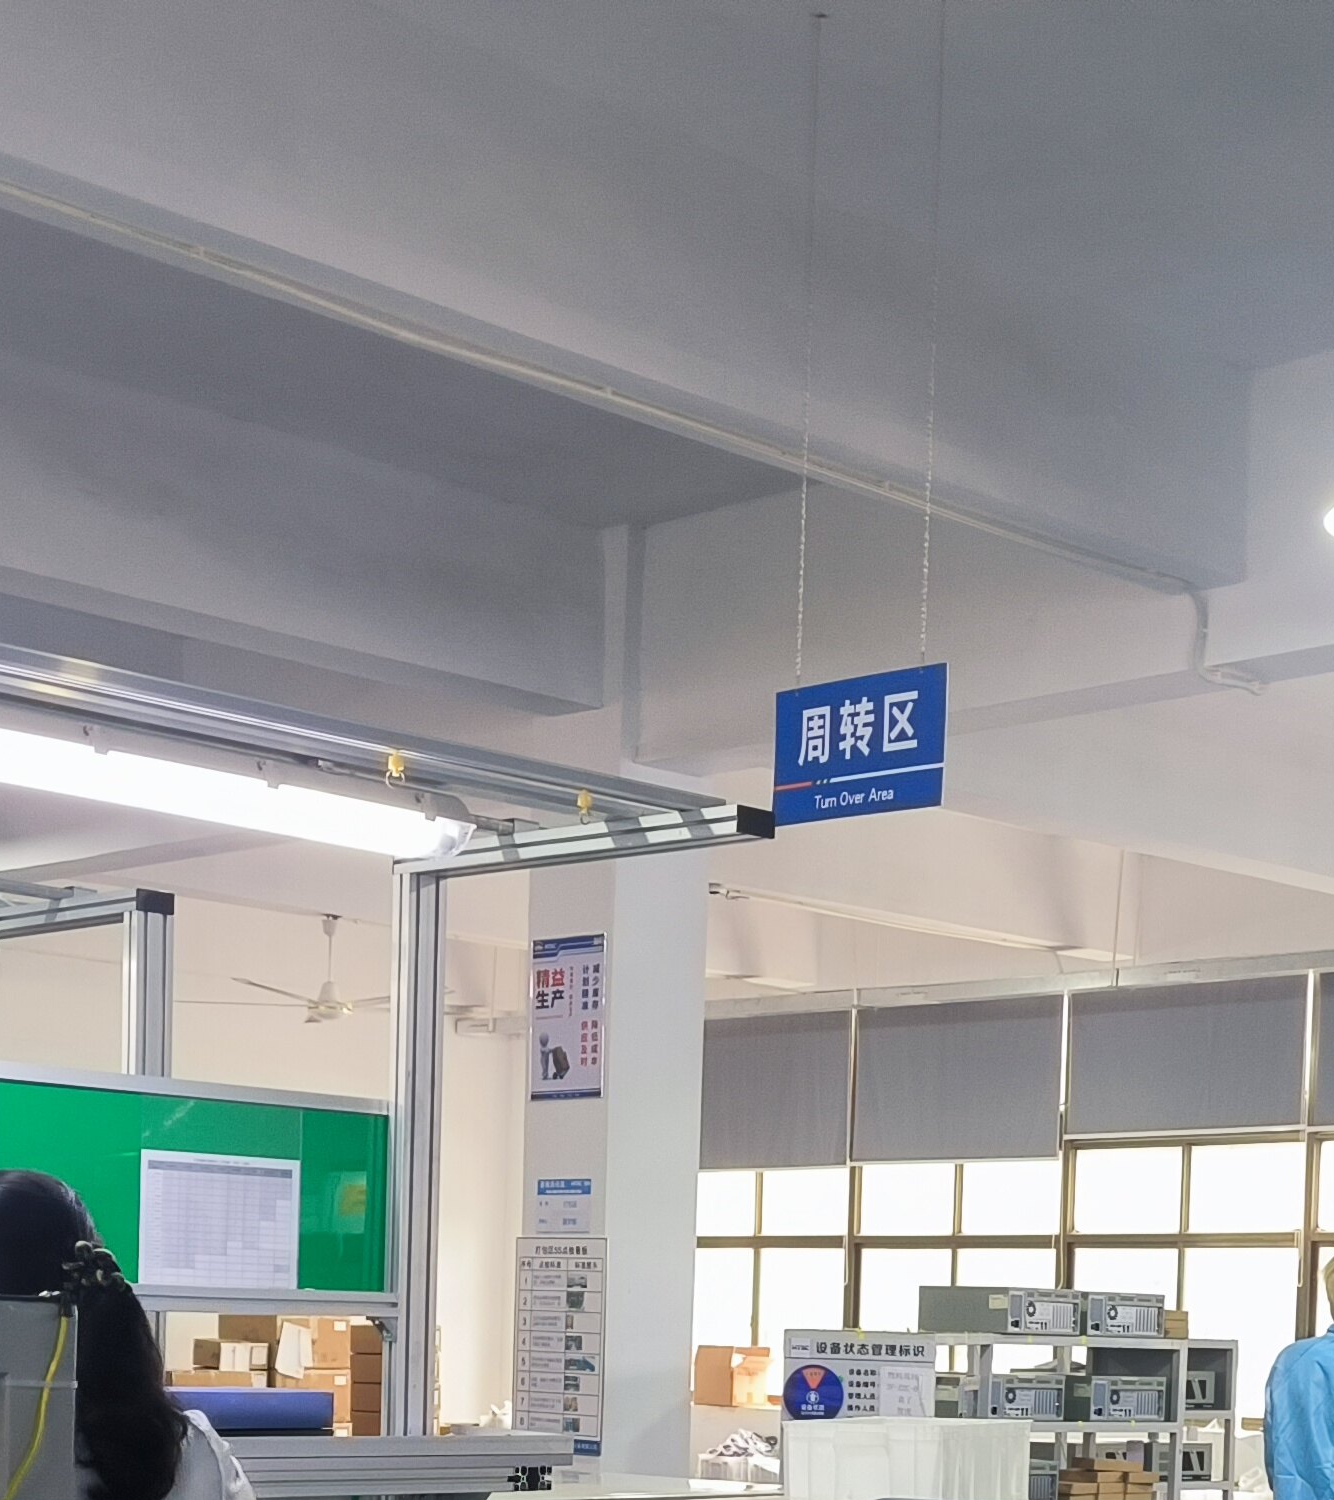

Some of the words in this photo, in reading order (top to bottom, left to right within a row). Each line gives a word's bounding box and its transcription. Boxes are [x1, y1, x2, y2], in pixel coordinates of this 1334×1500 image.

[798, 690, 919, 767] 周转区
[814, 794, 837, 810] Turn
[840, 791, 865, 806] Over
[868, 786, 894, 803] Area
[535, 989, 565, 1010] 生产
[816, 1341, 925, 1357] 设备状态管理标识
